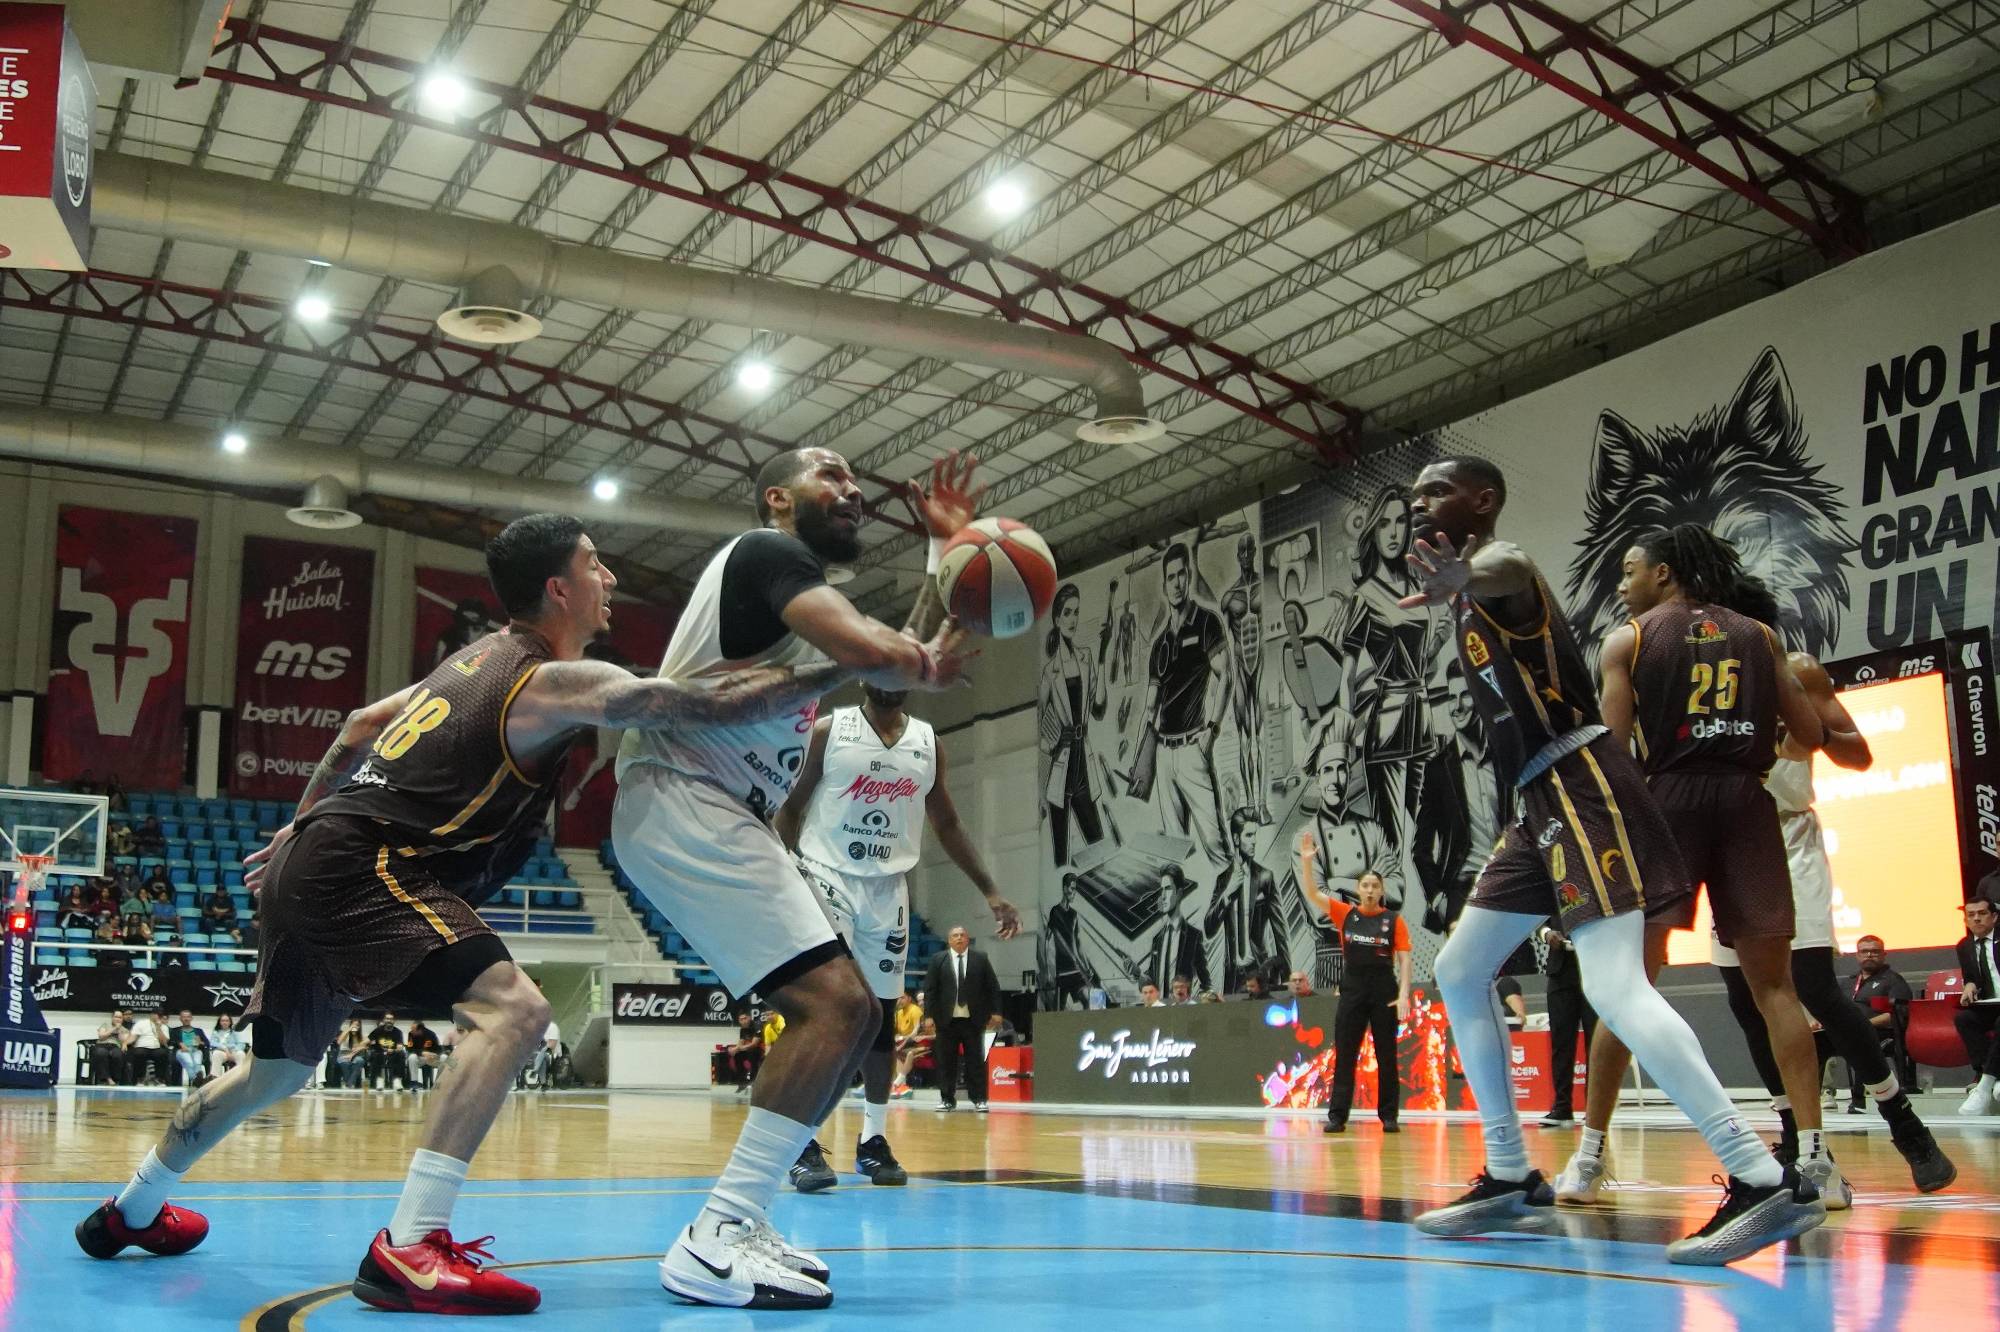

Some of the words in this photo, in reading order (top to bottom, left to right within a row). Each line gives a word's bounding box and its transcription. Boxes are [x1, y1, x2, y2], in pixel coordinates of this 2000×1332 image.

[65, 150, 87, 179] LOBO
[1863, 344, 1947, 424] NO
[1959, 321, 2000, 394] H
[1861, 484, 2000, 570] GRAN
[291, 560, 343, 587] Salsa
[262, 580, 345, 620] Huichol
[1867, 558, 1968, 651] UN
[1687, 658, 1741, 714] 25
[1691, 718, 1755, 739] debate
[1966, 675, 1987, 756] Chevron
[743, 751, 783, 785] Banco
[843, 823, 873, 836] Banco
[1975, 783, 2000, 858] telcel
[867, 843, 892, 860] UAD
[7, 936, 25, 1025] dportenis
[112, 993, 133, 1001] GRAN
[134, 994, 167, 1002] ACUARIO
[617, 992, 691, 1018] telcel
[704, 1011, 733, 1021] MEGA
[4, 1041, 53, 1067] UAD
[1078, 1031, 1114, 1071] San
[1104, 1029, 1151, 1078] Juan
[3, 1063, 50, 1074] MAZATLAN
[1131, 1071, 1190, 1083] ASADOR
